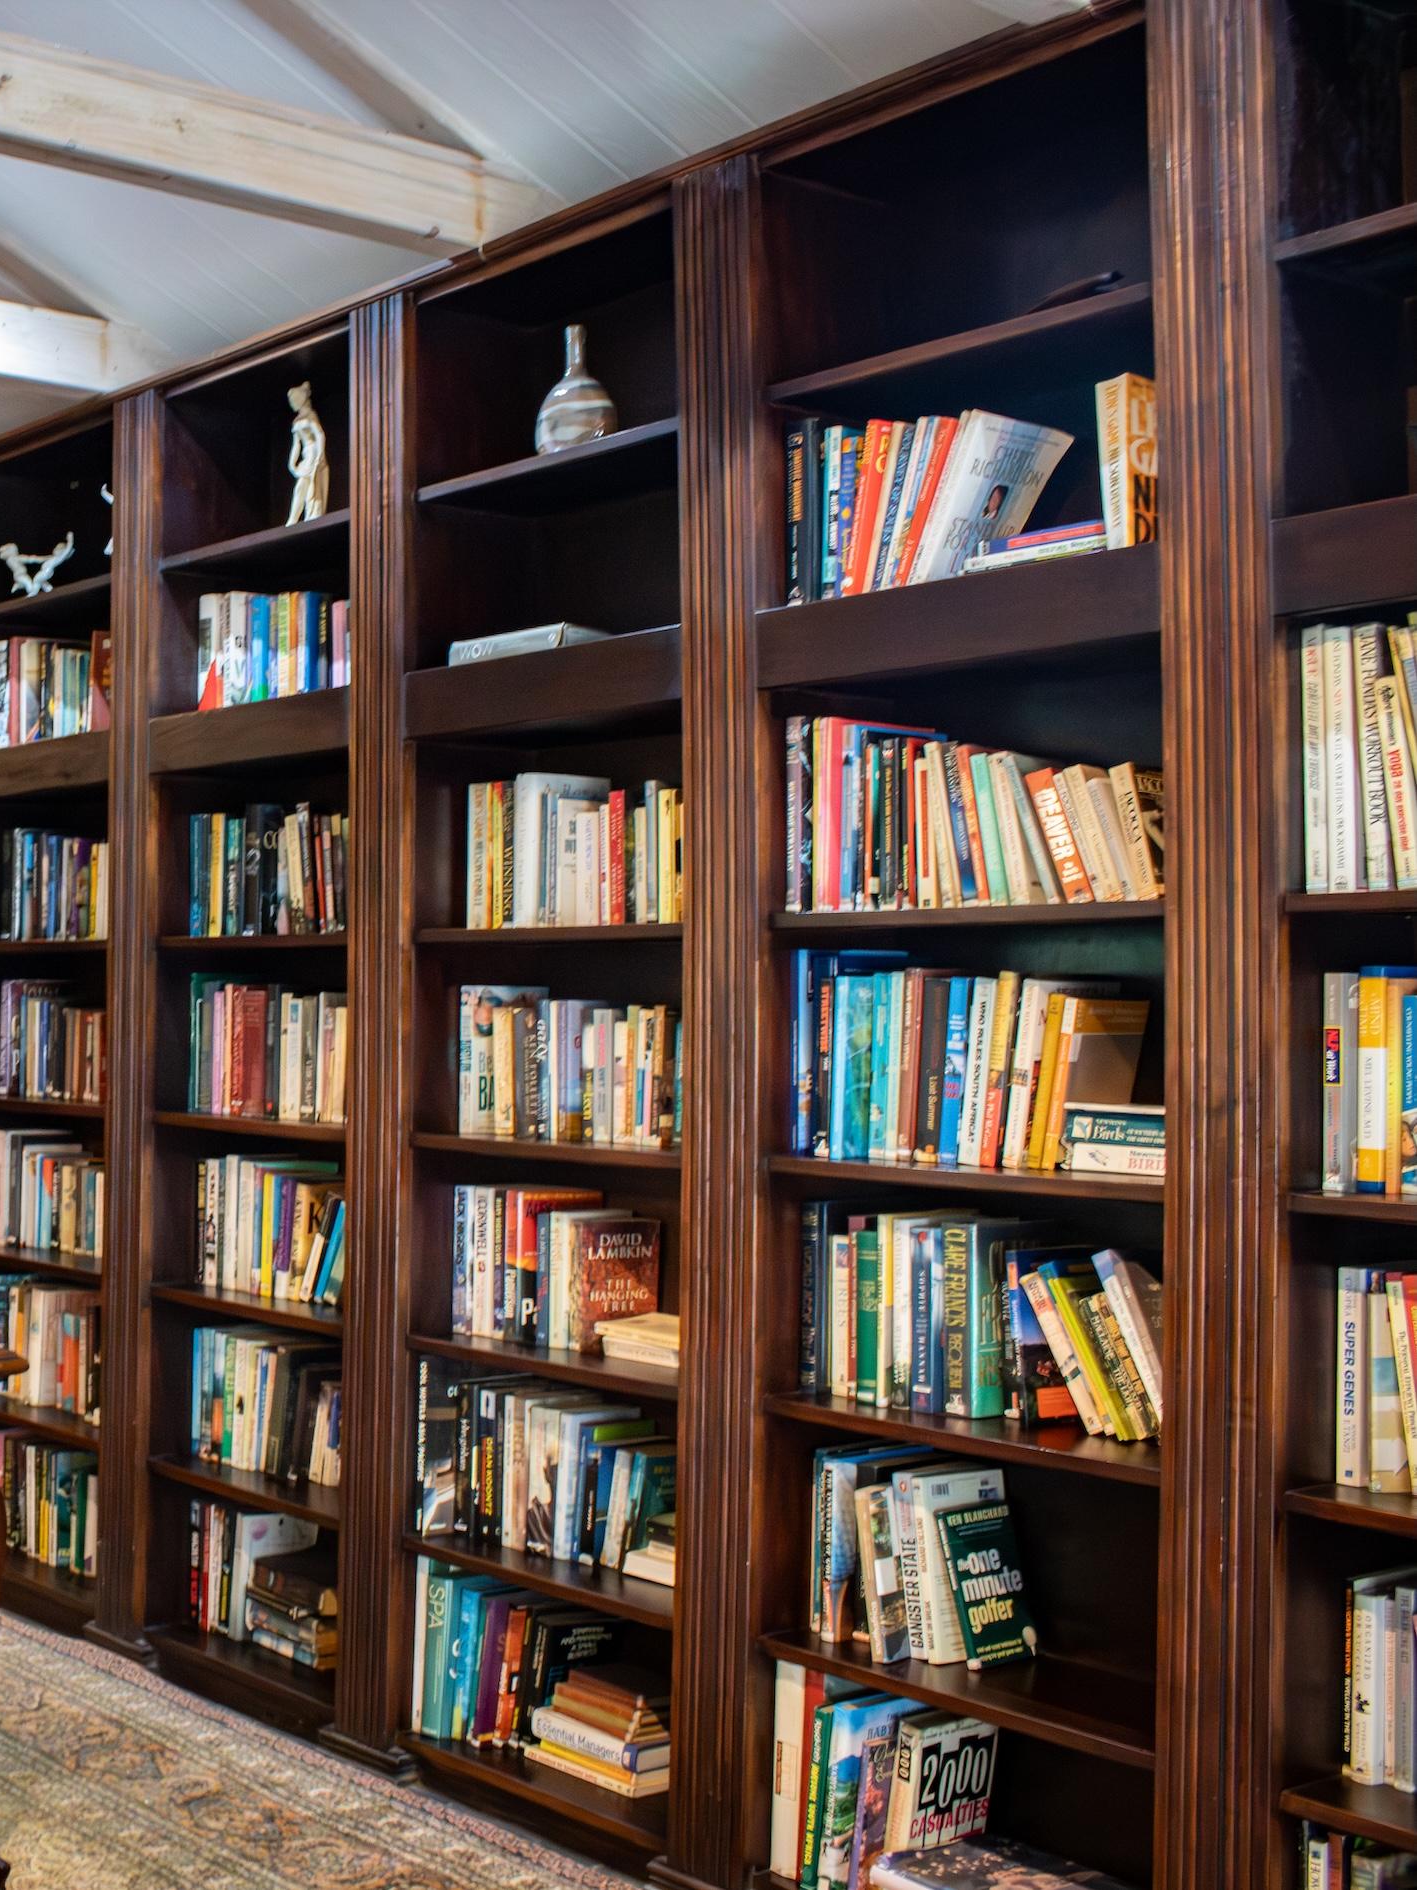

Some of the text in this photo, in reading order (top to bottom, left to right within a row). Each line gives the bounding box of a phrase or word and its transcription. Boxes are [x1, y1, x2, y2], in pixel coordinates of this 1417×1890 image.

[1359, 634, 1377, 666] JANE
[1363, 723, 1383, 785] WORKOUT
[1367, 790, 1386, 827] BOOK
[503, 845, 514, 916] WINNING
[1369, 999, 1382, 1036] MIND
[1327, 1029, 1339, 1051] NLP
[967, 1000, 987, 1144] WHO RULES SOUTH AFRICA?
[1326, 1060, 1337, 1082] Work
[1093, 1125, 1126, 1141] Birds
[587, 1245, 653, 1261] LAMBKIN
[599, 1232, 643, 1248] DAVID
[606, 1278, 633, 1291] THE
[944, 1228, 968, 1327] CLARE FRANCIS
[589, 1289, 649, 1303] HANGING
[601, 1300, 637, 1313] TREE
[917, 1269, 927, 1384] SOPHIE HANNAH
[1344, 1320, 1355, 1366] SUPER
[419, 1361, 428, 1386] COOL
[948, 1332, 964, 1389] REQUIEM
[418, 1387, 427, 1420] HOTELS
[1344, 1370, 1355, 1416] GENES
[485, 1436, 495, 1516] DEAN KOONTZ
[947, 1504, 1010, 1527] KEN BLANCHARD
[823, 1557, 832, 1582] GOLF
[918, 1546, 928, 1573] RICHARD
[967, 1547, 1002, 1575] one
[901, 1537, 925, 1649] GANGSTER STATE
[961, 1565, 1024, 1603] minute
[427, 1583, 446, 1629] SPA
[968, 1596, 1014, 1635] golfer
[927, 1632, 936, 1650] MAKE
[1364, 1615, 1372, 1680] ORGANIZED
[1344, 1677, 1352, 1712] REVELLING
[535, 1718, 621, 1763] Essential Managers
[1343, 1733, 1351, 1753] WILD
[809, 1763, 821, 1803] AWESOME
[921, 1745, 989, 1810] 2000
[806, 1803, 816, 1831] SOUTH
[909, 1797, 991, 1841] CASUALTIES
[804, 1831, 816, 1866] AFRICA
